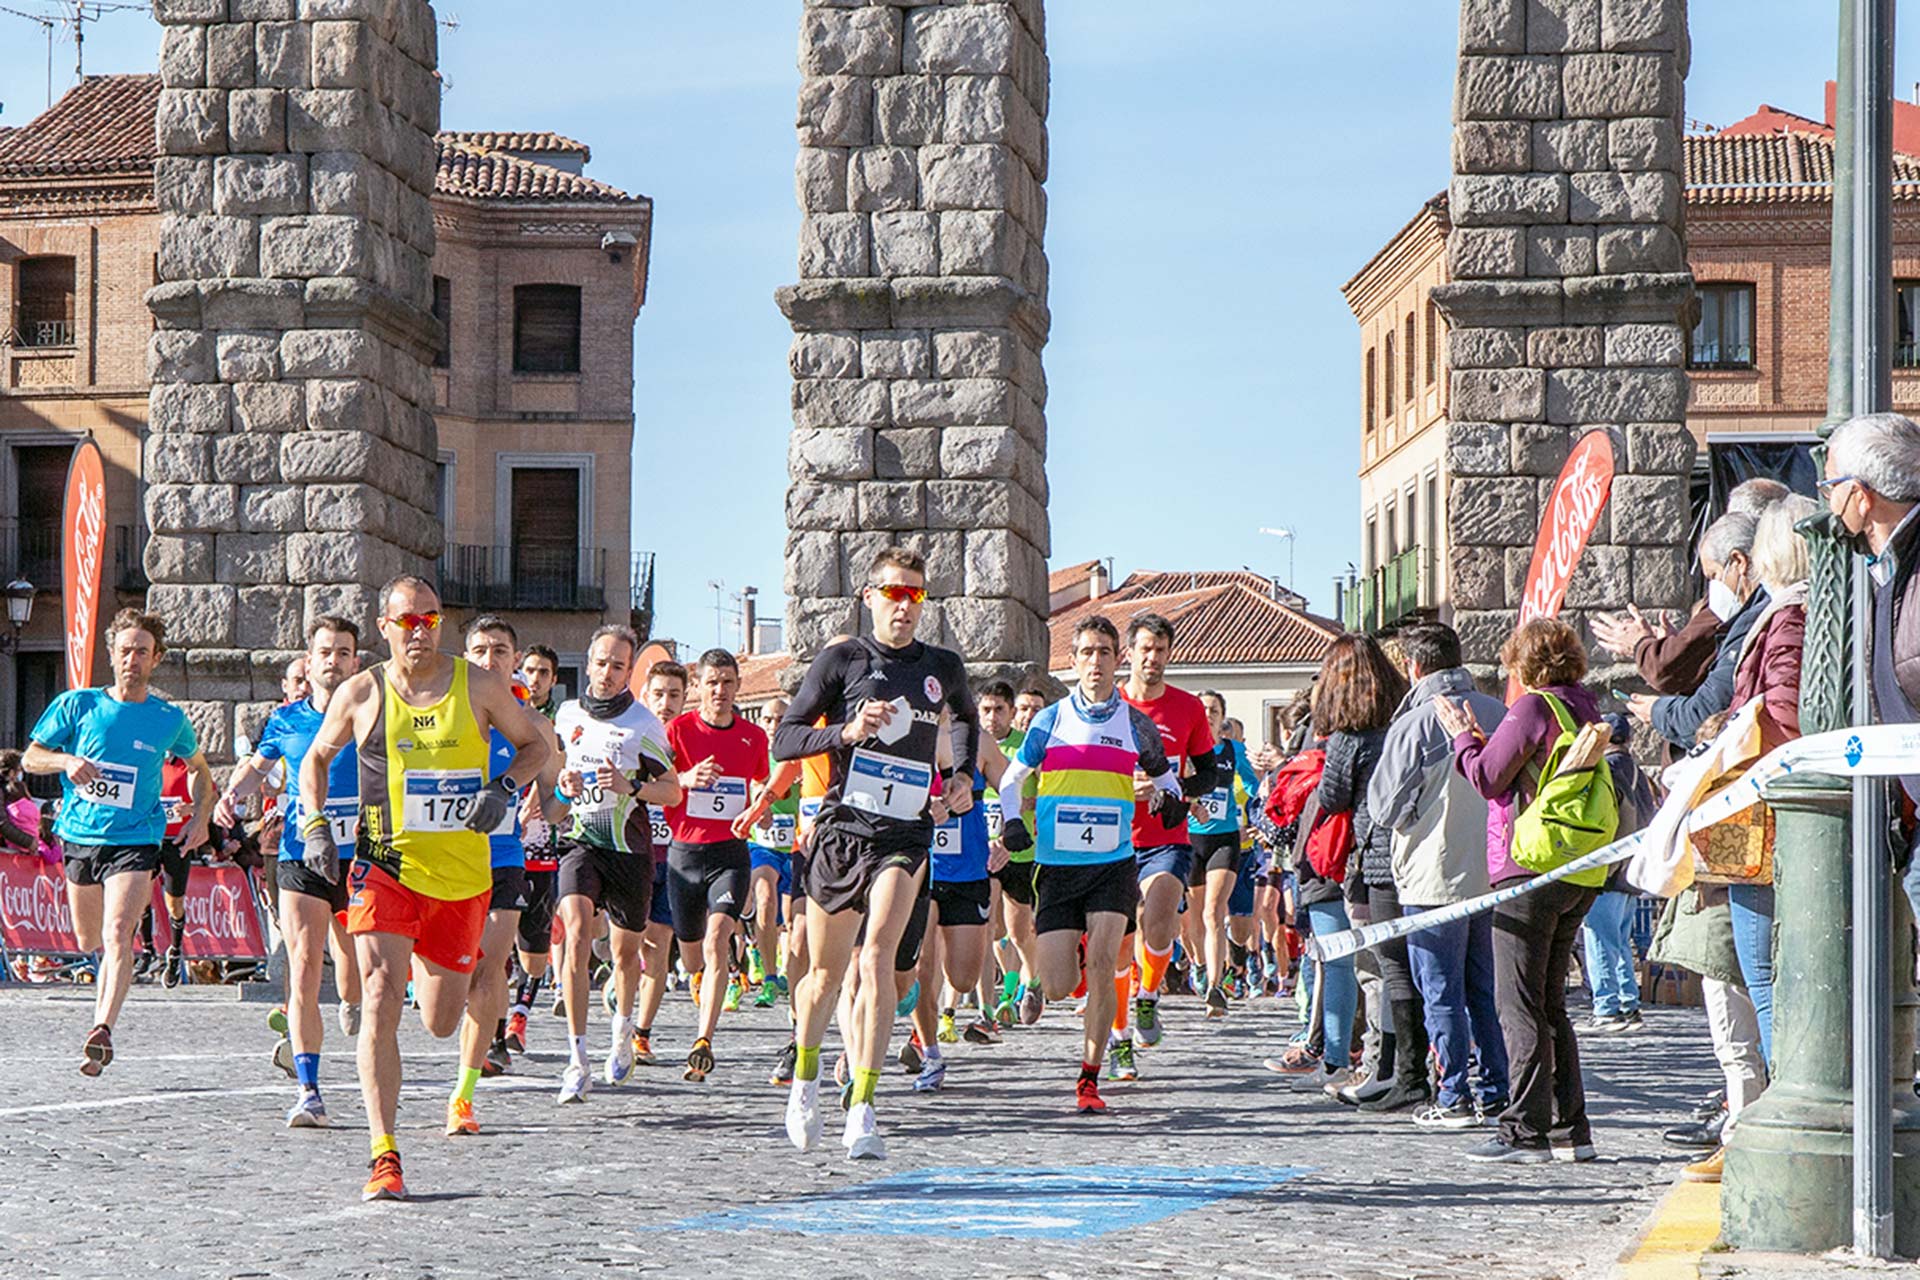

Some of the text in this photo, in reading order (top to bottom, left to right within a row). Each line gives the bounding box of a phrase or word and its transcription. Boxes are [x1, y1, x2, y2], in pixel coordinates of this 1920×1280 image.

[712, 795, 725, 813] 5
[882, 782, 895, 806] 1
[424, 797, 469, 822] 178
[1080, 826, 1095, 845] 4
